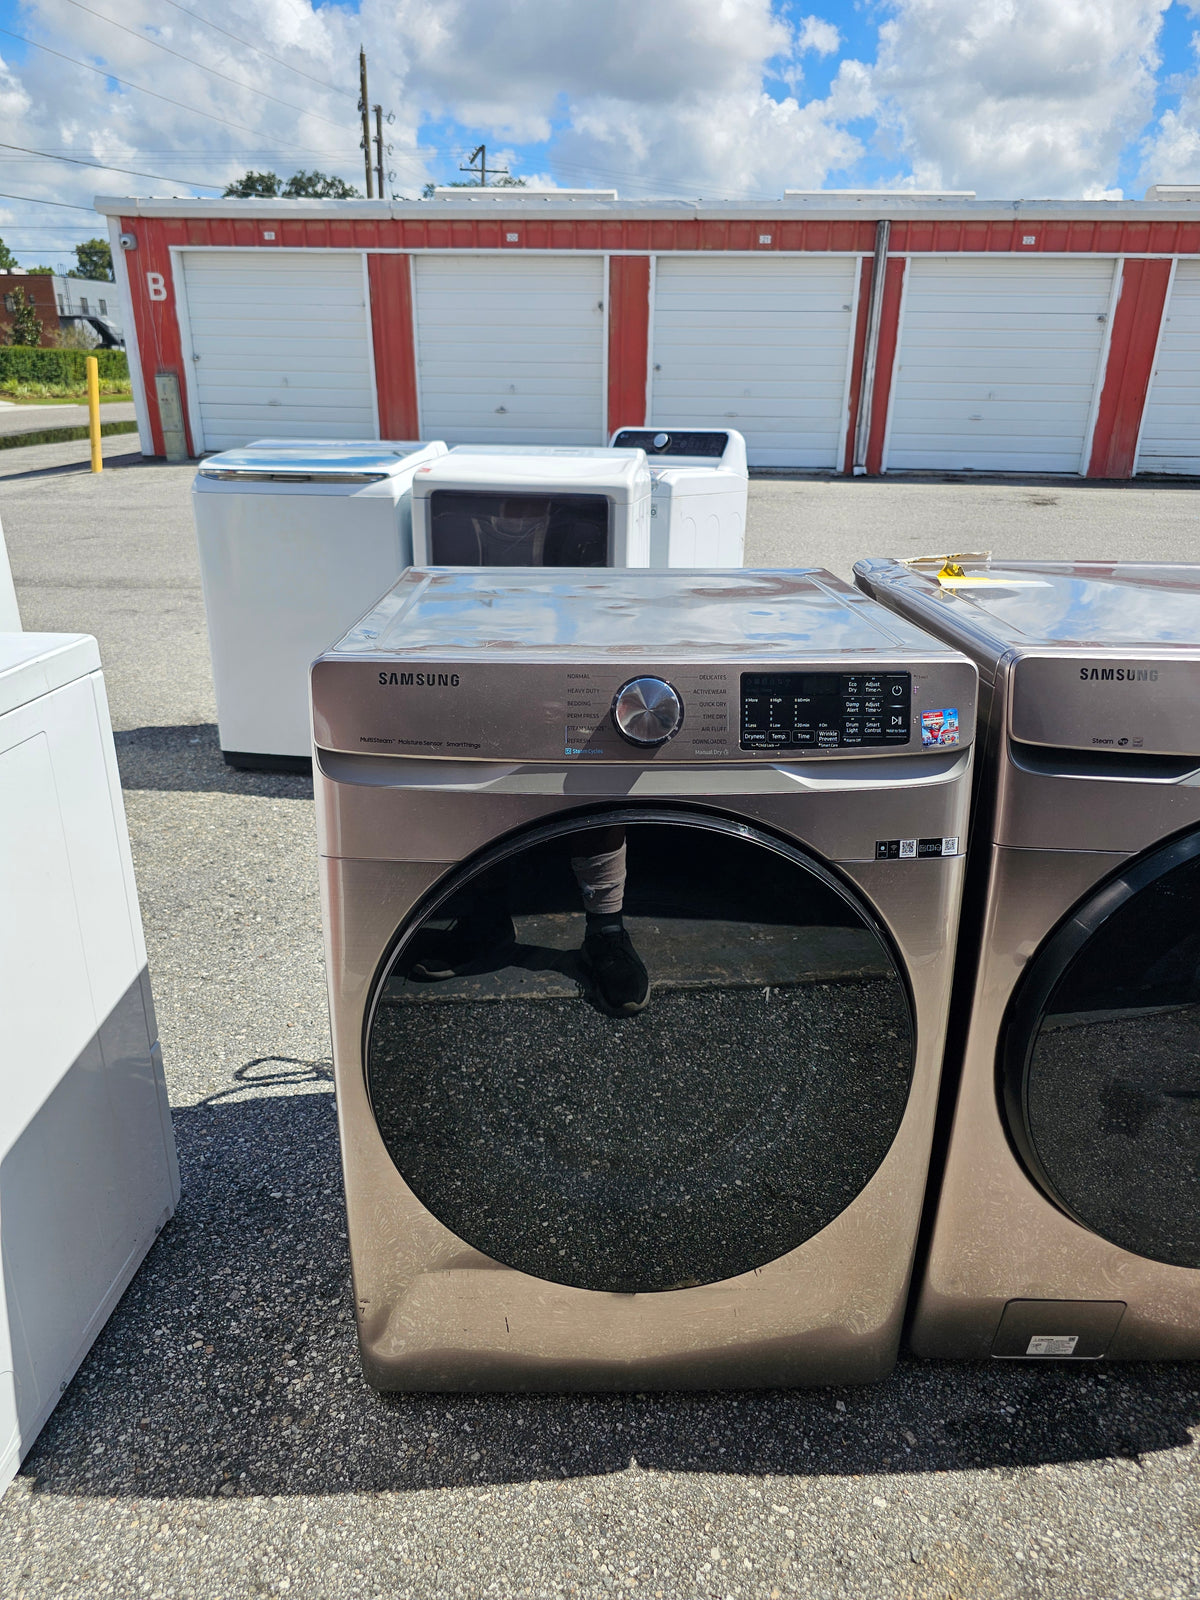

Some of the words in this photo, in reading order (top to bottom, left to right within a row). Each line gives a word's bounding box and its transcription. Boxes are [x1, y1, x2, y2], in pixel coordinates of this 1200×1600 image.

[146, 272, 167, 301] B
[379, 672, 460, 686] SAMSUNG
[1080, 668, 1159, 681] SAMSUNG
[446, 741, 481, 749] SmartThings
